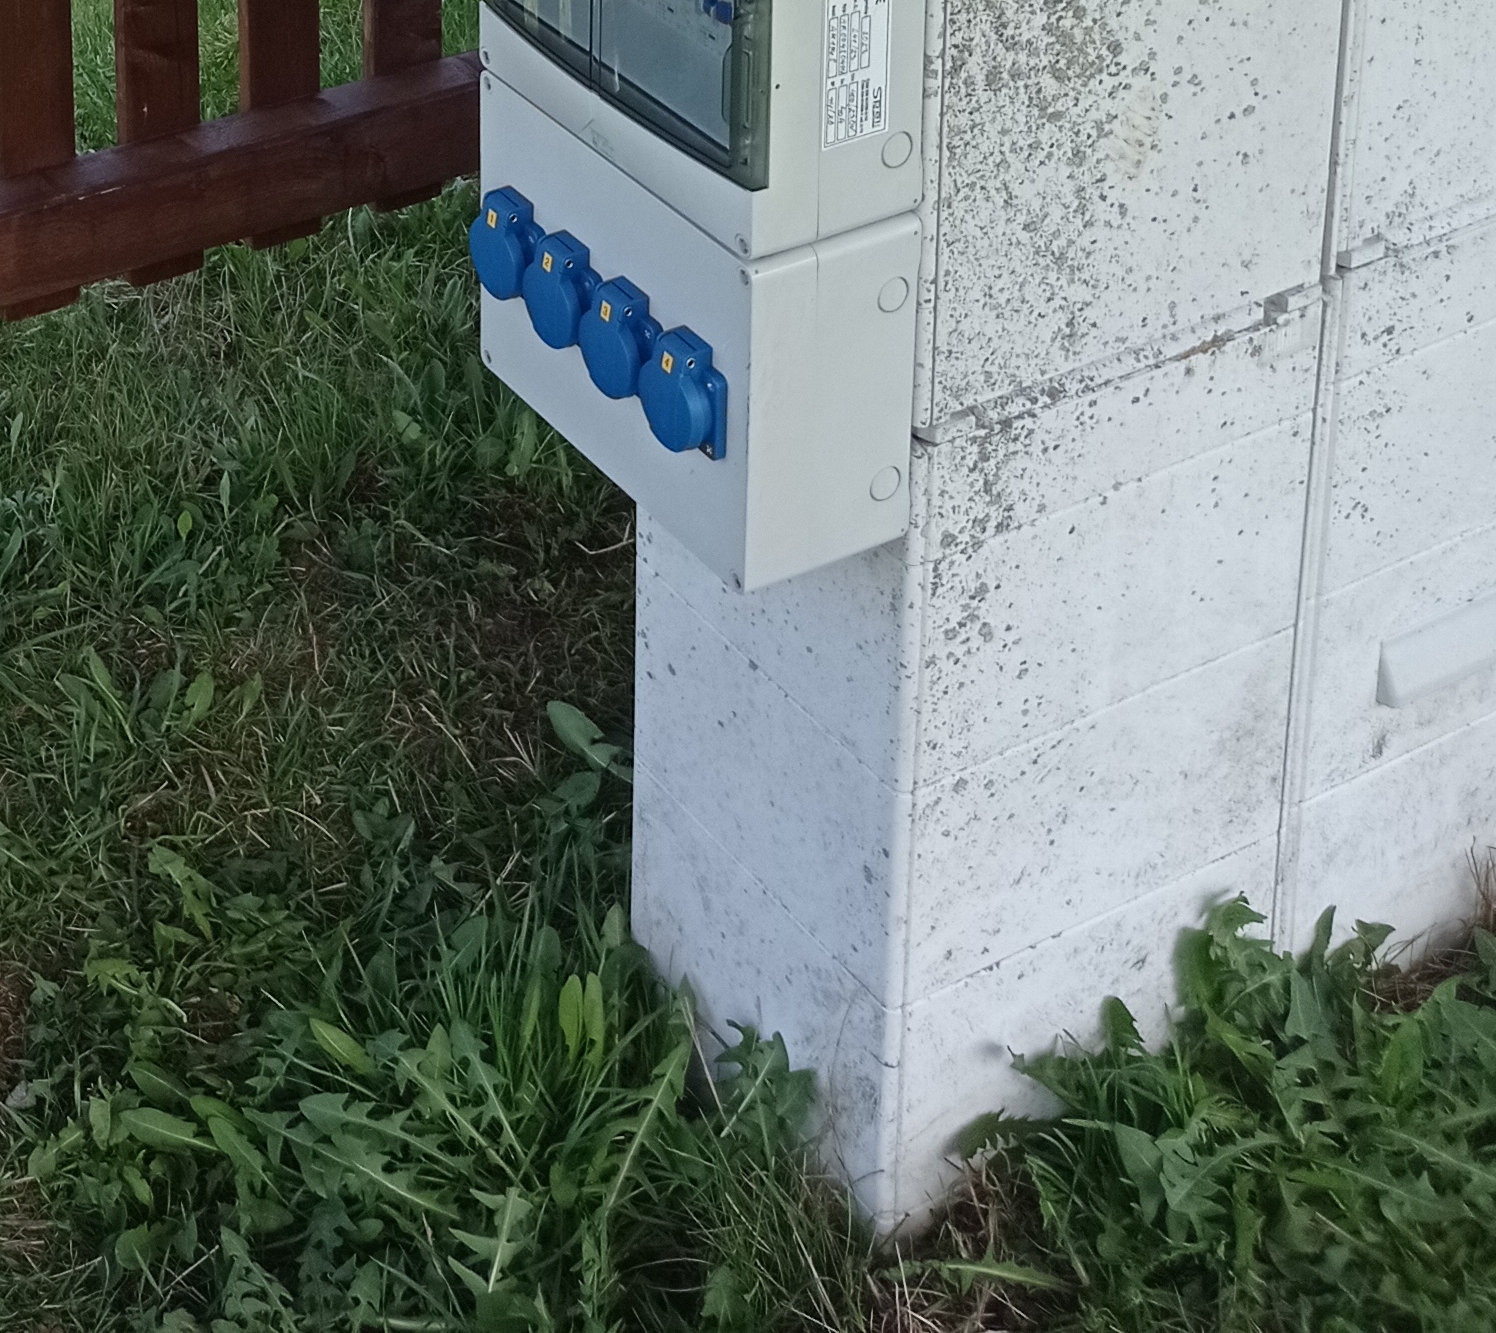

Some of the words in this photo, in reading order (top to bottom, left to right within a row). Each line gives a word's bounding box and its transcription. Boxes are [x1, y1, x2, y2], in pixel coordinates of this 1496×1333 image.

[489, 213, 495, 224] 1
[544, 257, 550, 267] 2
[602, 306, 609, 317] 3
[664, 357, 671, 368] 4
